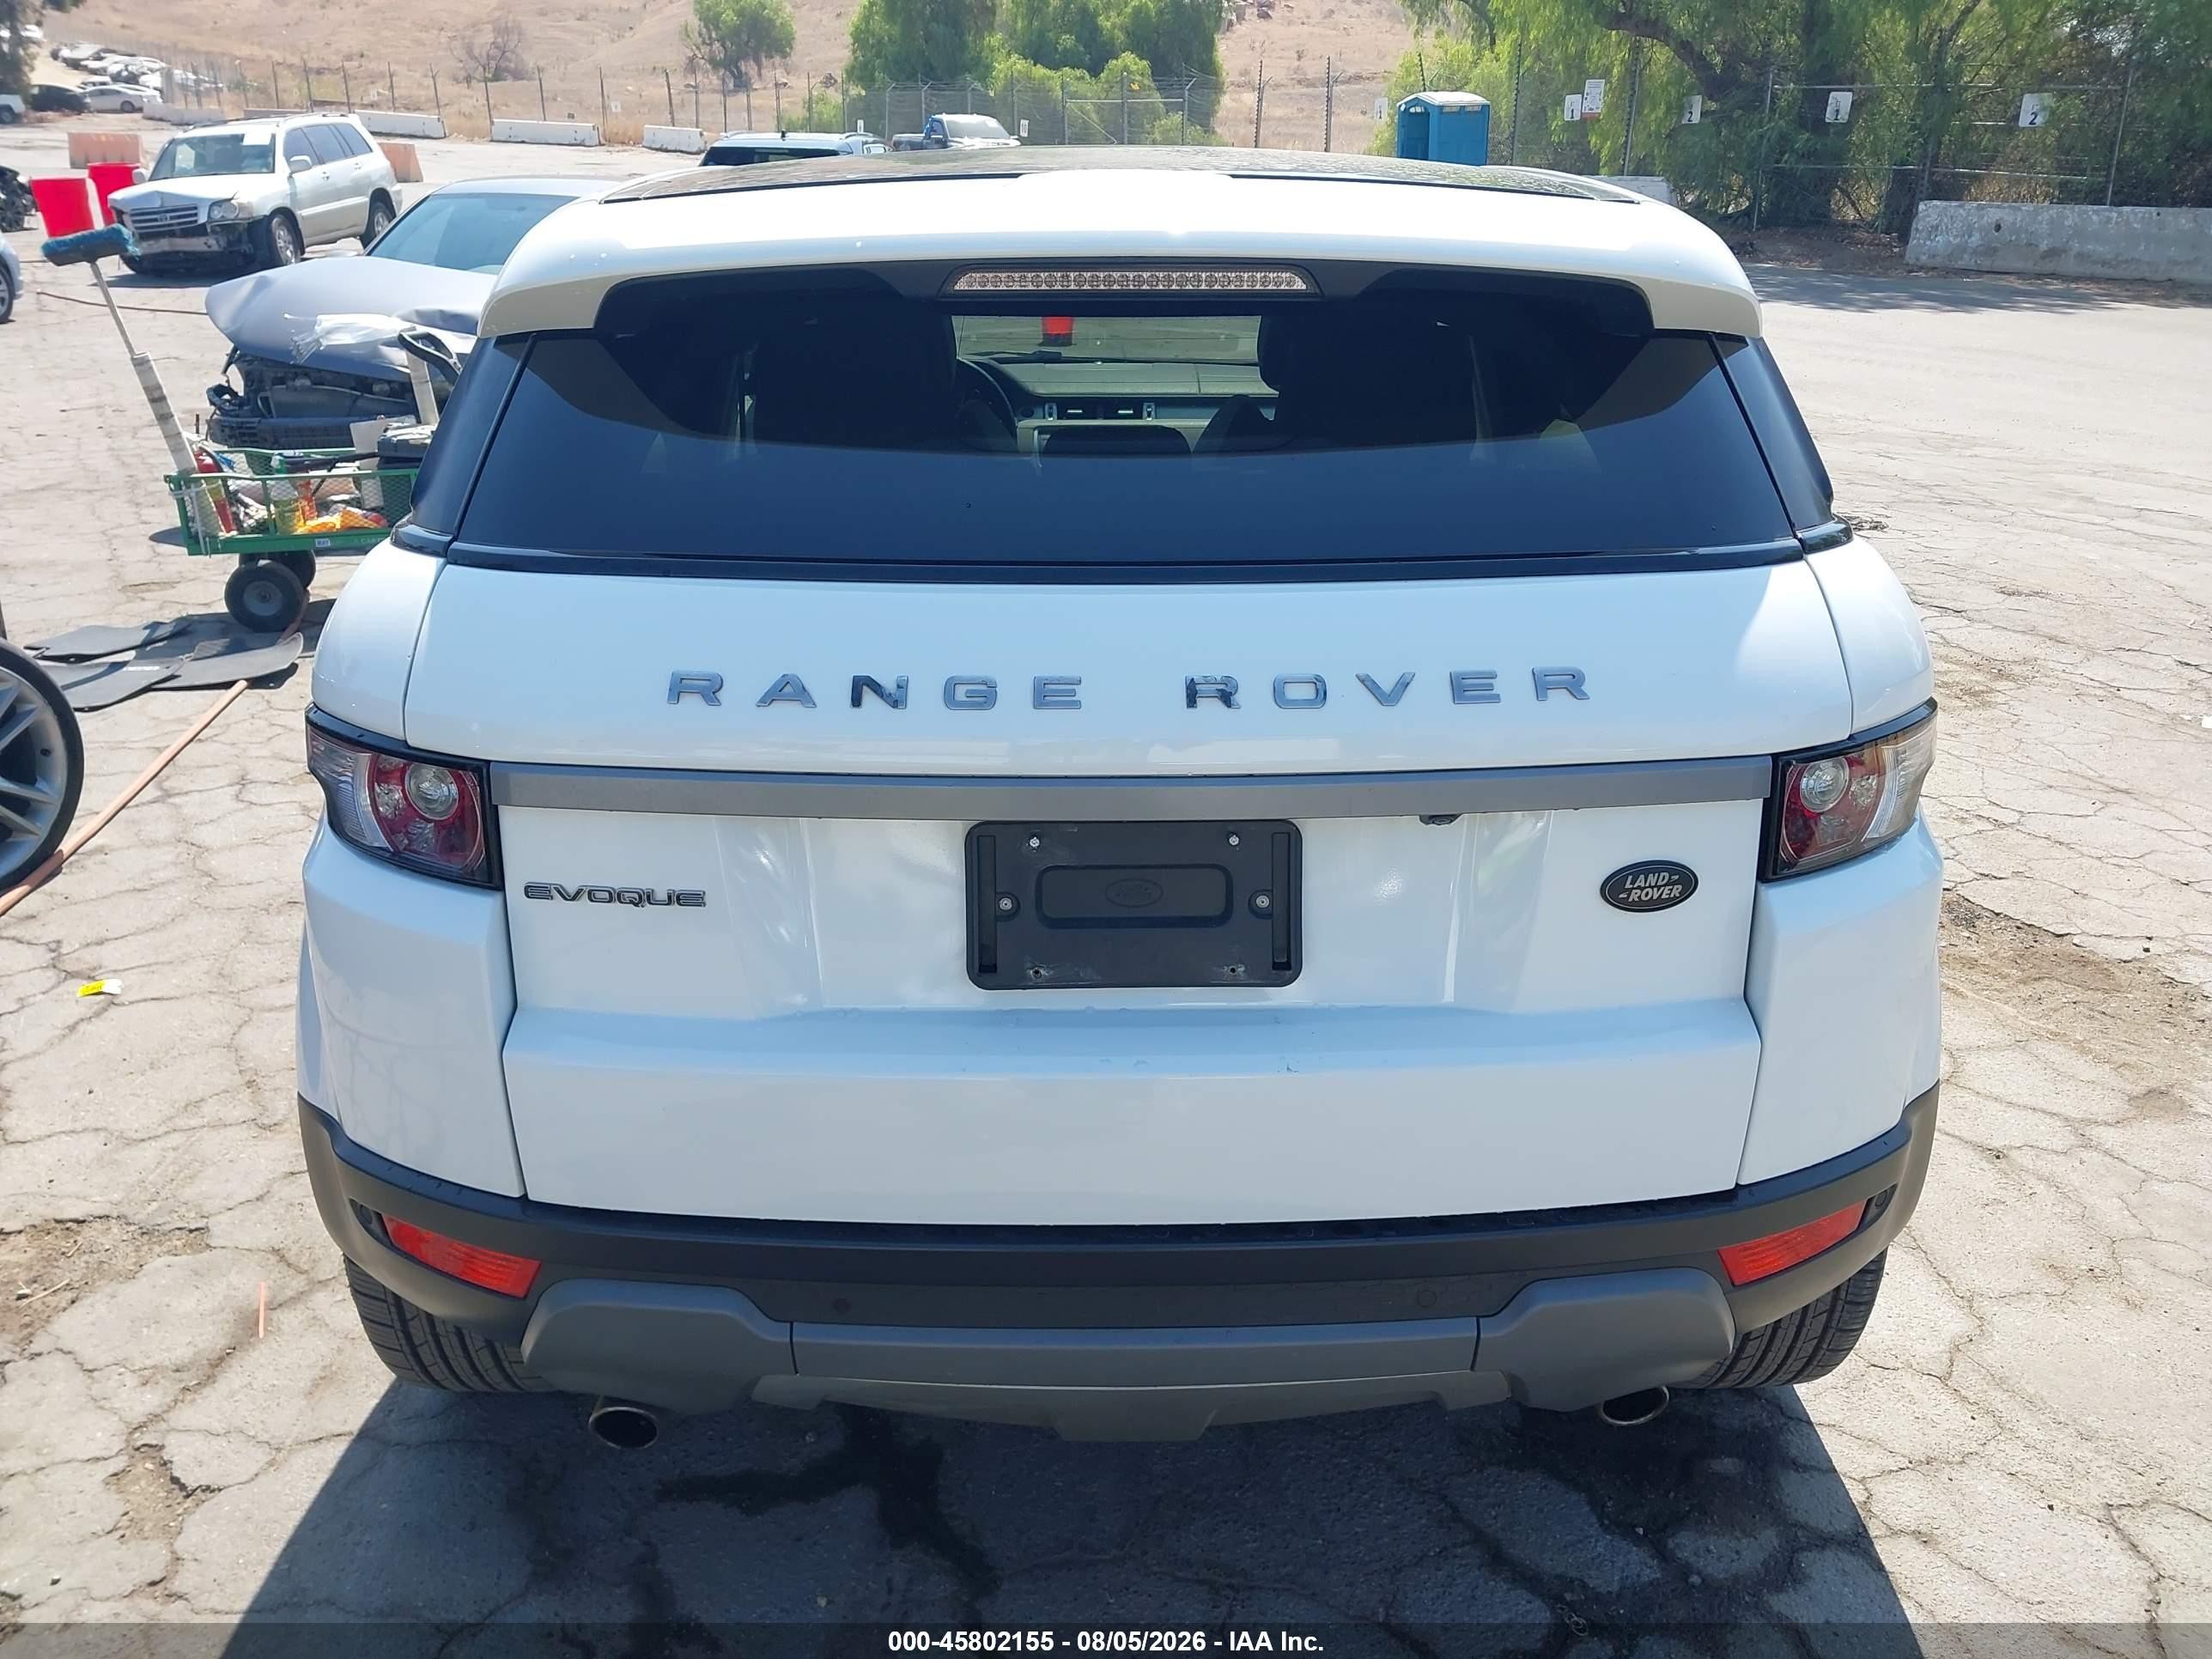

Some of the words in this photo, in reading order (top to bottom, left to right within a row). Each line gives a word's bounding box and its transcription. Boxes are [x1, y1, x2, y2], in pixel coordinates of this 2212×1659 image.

[1687, 111, 1693, 122] 2
[1833, 108, 1840, 120] 1
[2028, 112, 2038, 125] 2
[665, 670, 1083, 711] RANGE
[1184, 665, 1590, 710] ROVER
[1624, 872, 1669, 889] LAND
[523, 882, 707, 908] EVOQUE
[1627, 884, 1683, 902] ROVER
